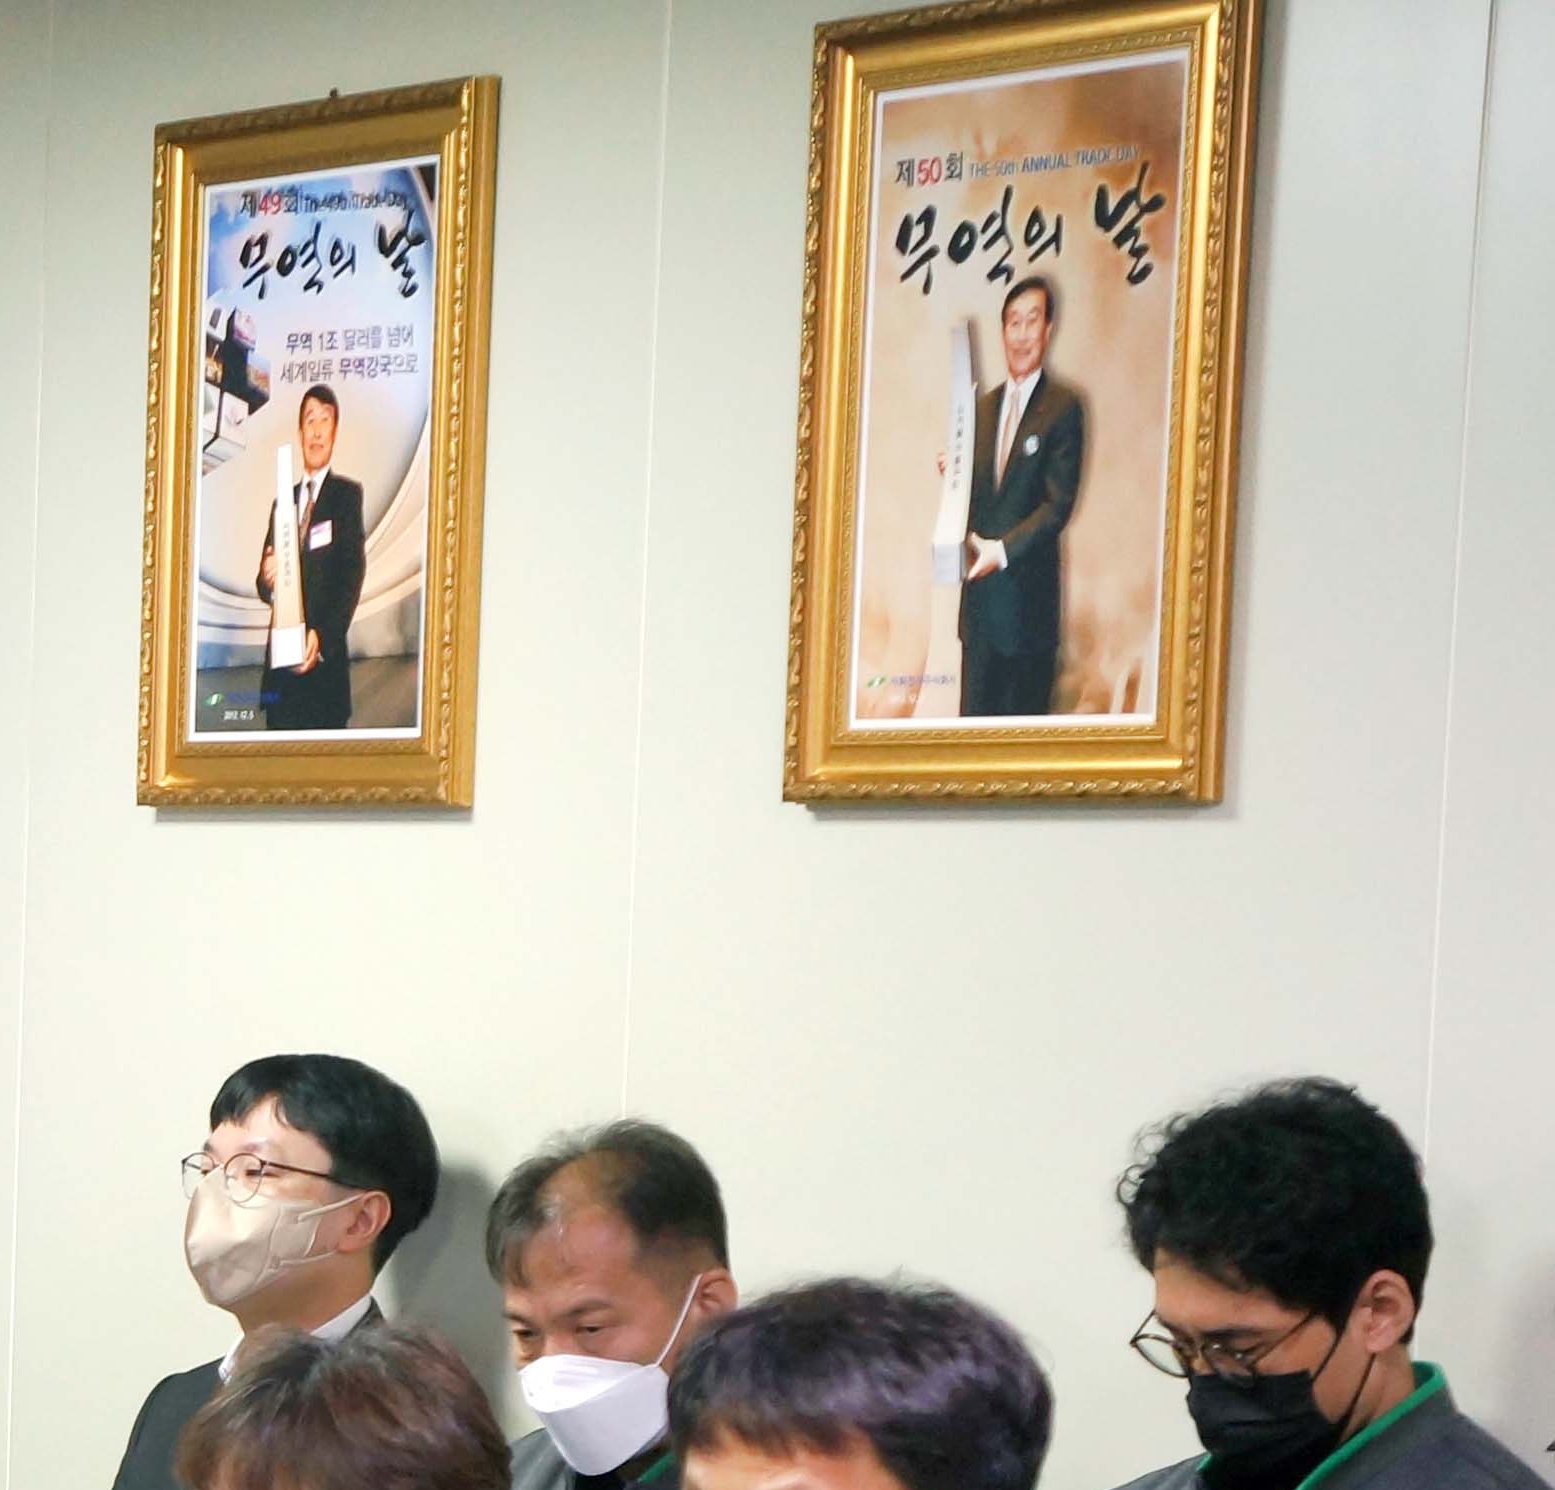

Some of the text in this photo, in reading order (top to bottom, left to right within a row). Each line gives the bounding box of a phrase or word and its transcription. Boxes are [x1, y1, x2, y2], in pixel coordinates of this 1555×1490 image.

[894, 151, 964, 188] 제50회
[1021, 153, 1073, 173] ANNUAL
[894, 160, 1167, 296] 무역의 날
[239, 209, 427, 300] 무역의 날
[286, 332, 313, 355] 무역
[279, 357, 334, 384] 세계일류
